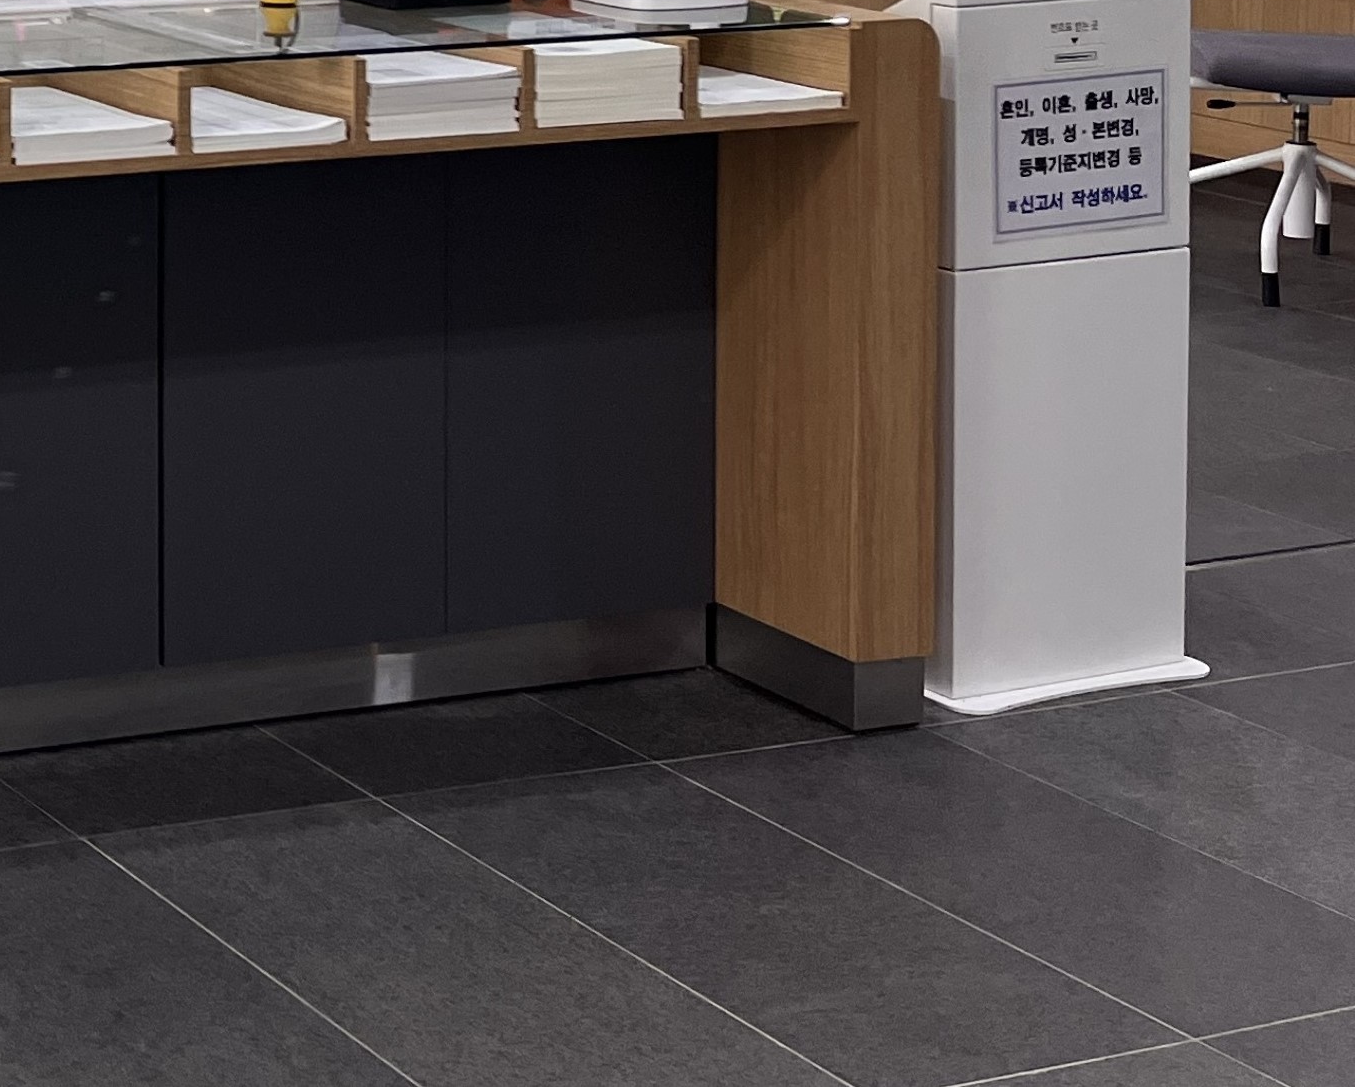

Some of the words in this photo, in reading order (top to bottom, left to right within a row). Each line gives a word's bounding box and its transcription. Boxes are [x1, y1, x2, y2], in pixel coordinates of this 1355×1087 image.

[1000, 98, 1035, 119] 혼인,
[1041, 94, 1077, 115] 이혼,
[1084, 89, 1118, 111] 출생,
[1125, 85, 1159, 106] 사망,
[1020, 126, 1055, 147] 개명,
[1062, 124, 1077, 143] 성
[1092, 117, 1140, 140] 본변경,
[1019, 148, 1121, 178] 등록기준지변경
[1127, 146, 1143, 165] 등
[1071, 183, 1148, 208] 작성하세요.
